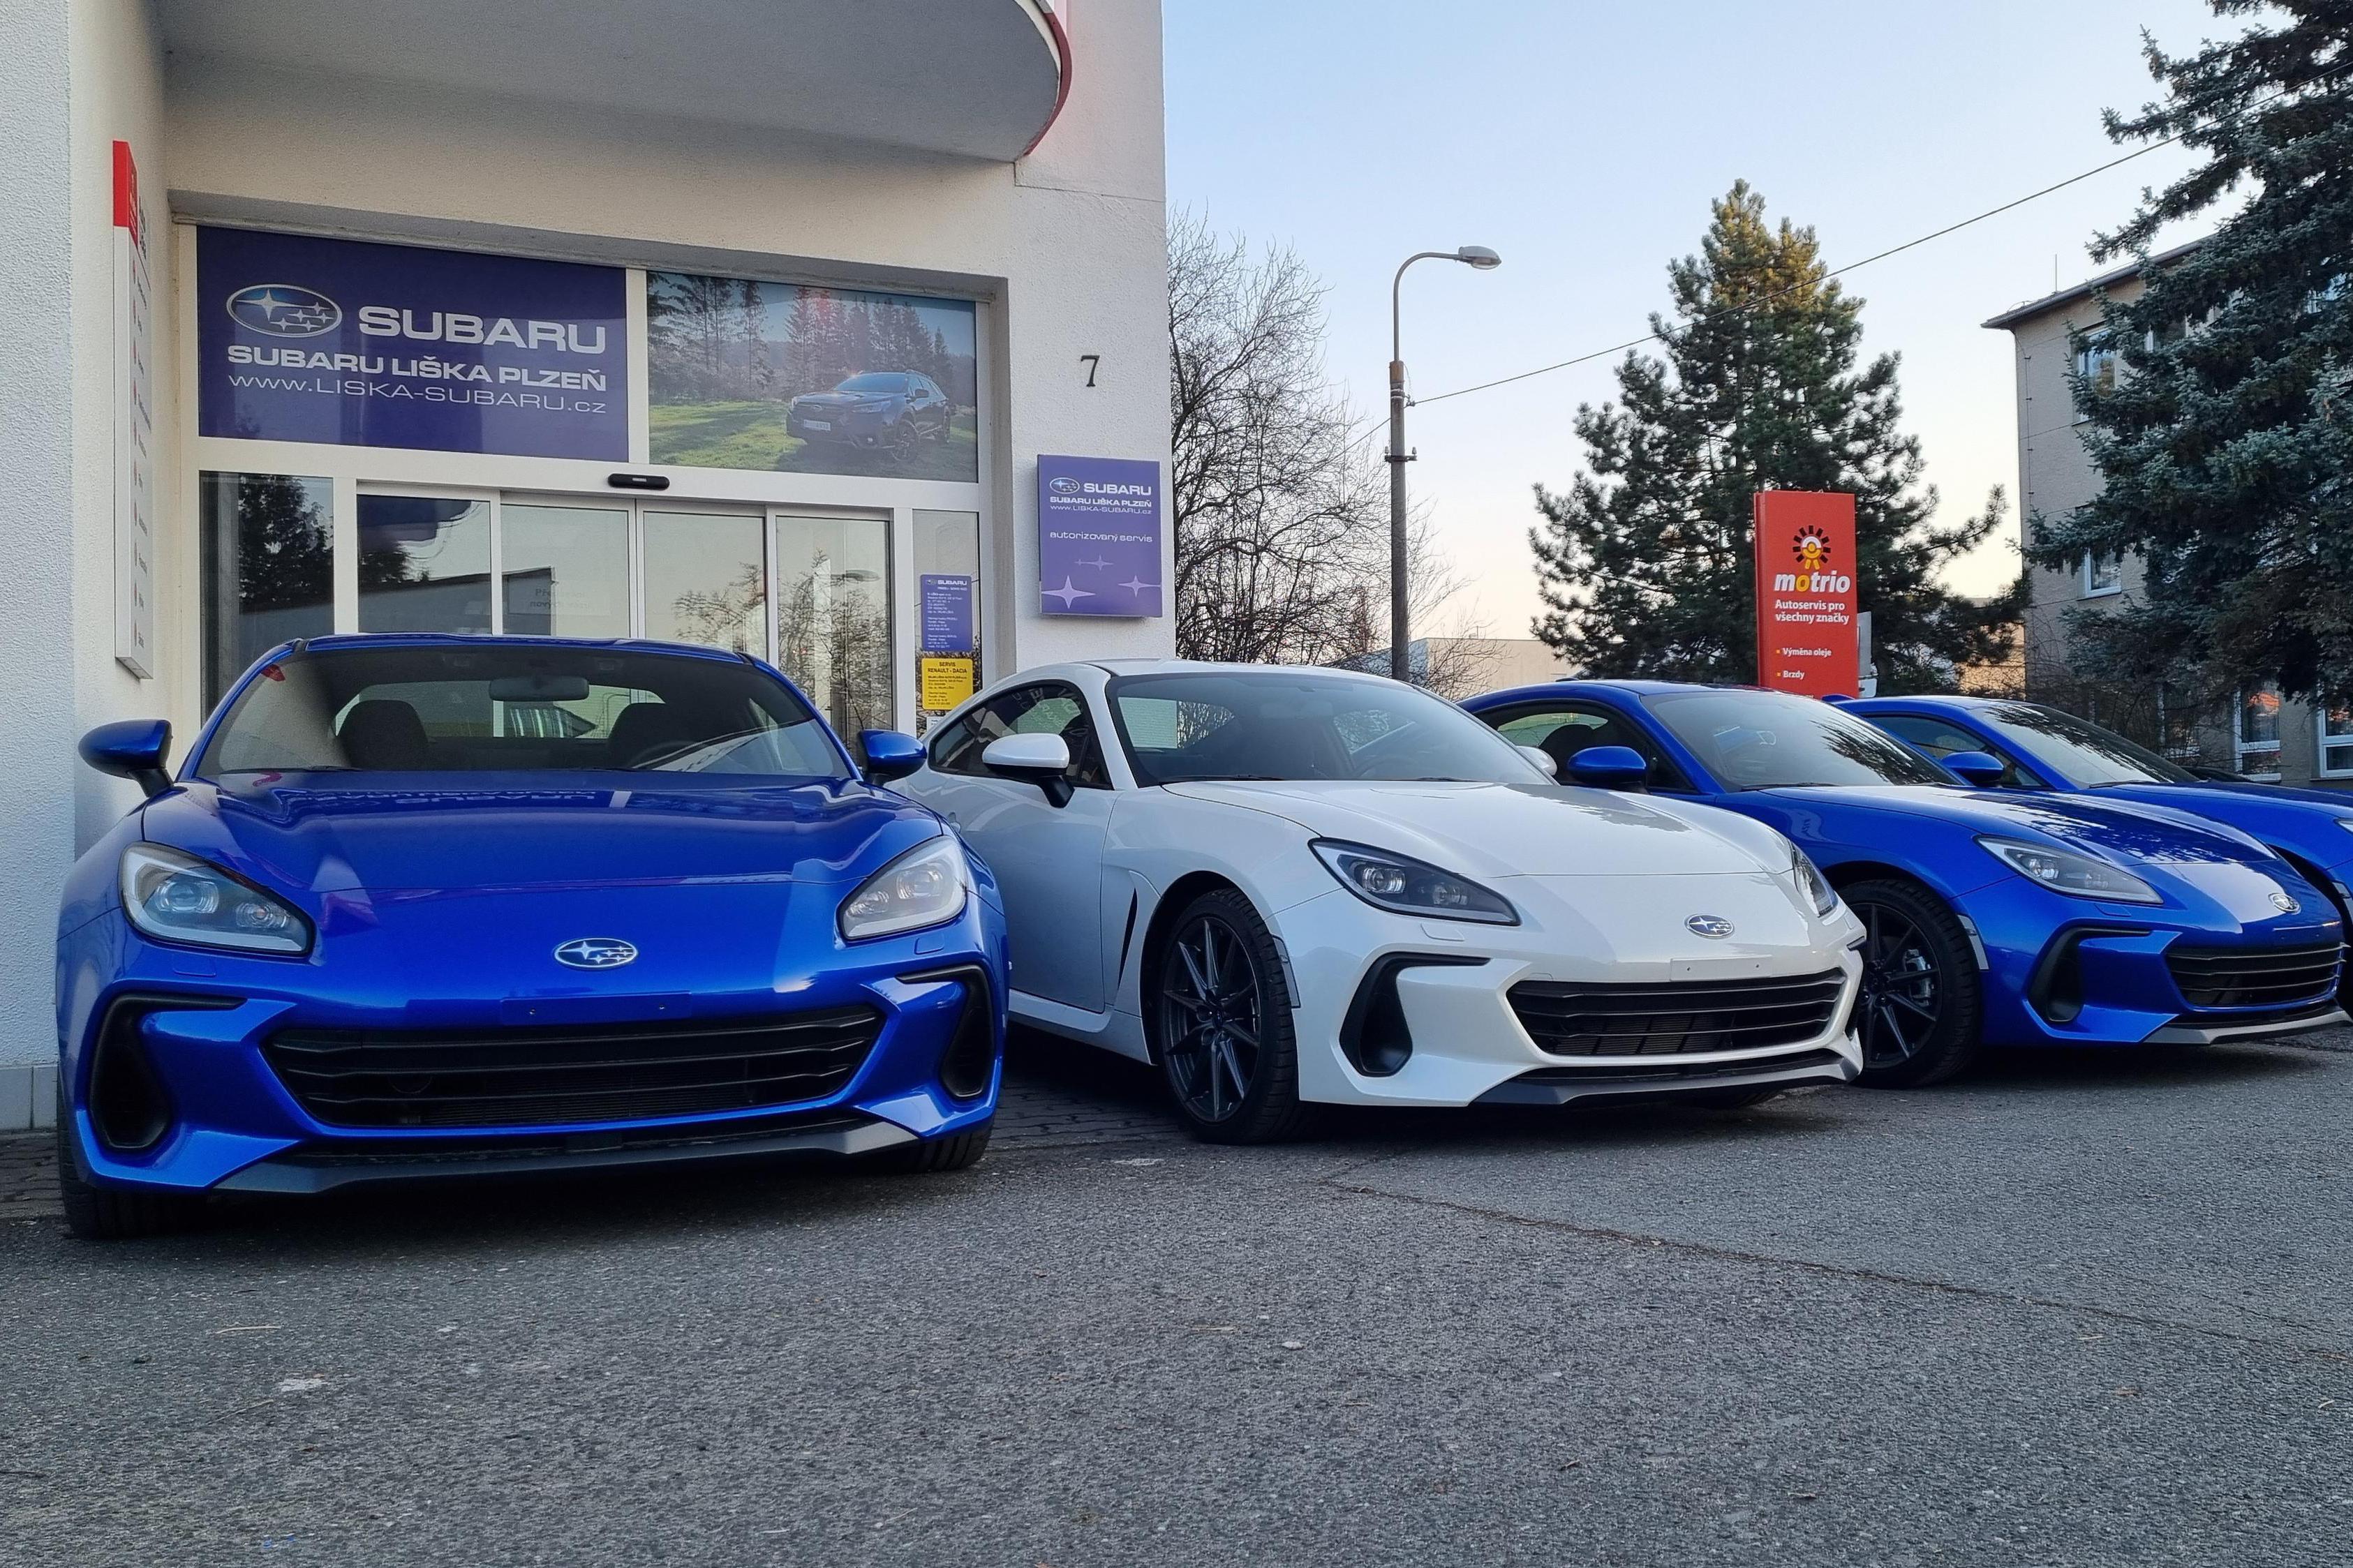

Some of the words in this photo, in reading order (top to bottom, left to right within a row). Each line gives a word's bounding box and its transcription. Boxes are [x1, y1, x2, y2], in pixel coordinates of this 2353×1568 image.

[358, 305, 606, 354] SUBARU
[227, 345, 384, 373] SUBARU
[392, 356, 493, 382] LIŠKA
[498, 368, 606, 391] PLZEŇ
[1081, 354, 1100, 387] 7
[1083, 483, 1152, 495] SUBARU
[1050, 496, 1091, 505] SUBARU
[1092, 497, 1120, 506] LIŠKA
[1121, 499, 1152, 507] PLZEŇ
[1050, 531, 1118, 543] autorizovaný
[1120, 535, 1152, 543] servis
[1774, 570, 1850, 592] motrio
[1775, 599, 1827, 610] Autoservis
[1828, 603, 1845, 612] pro
[1776, 611, 1815, 624] všechny
[1816, 612, 1850, 625] značky
[1783, 647, 1813, 657] Výměna
[1813, 648, 1832, 657] oleje
[1783, 670, 1805, 680] Brzdy
